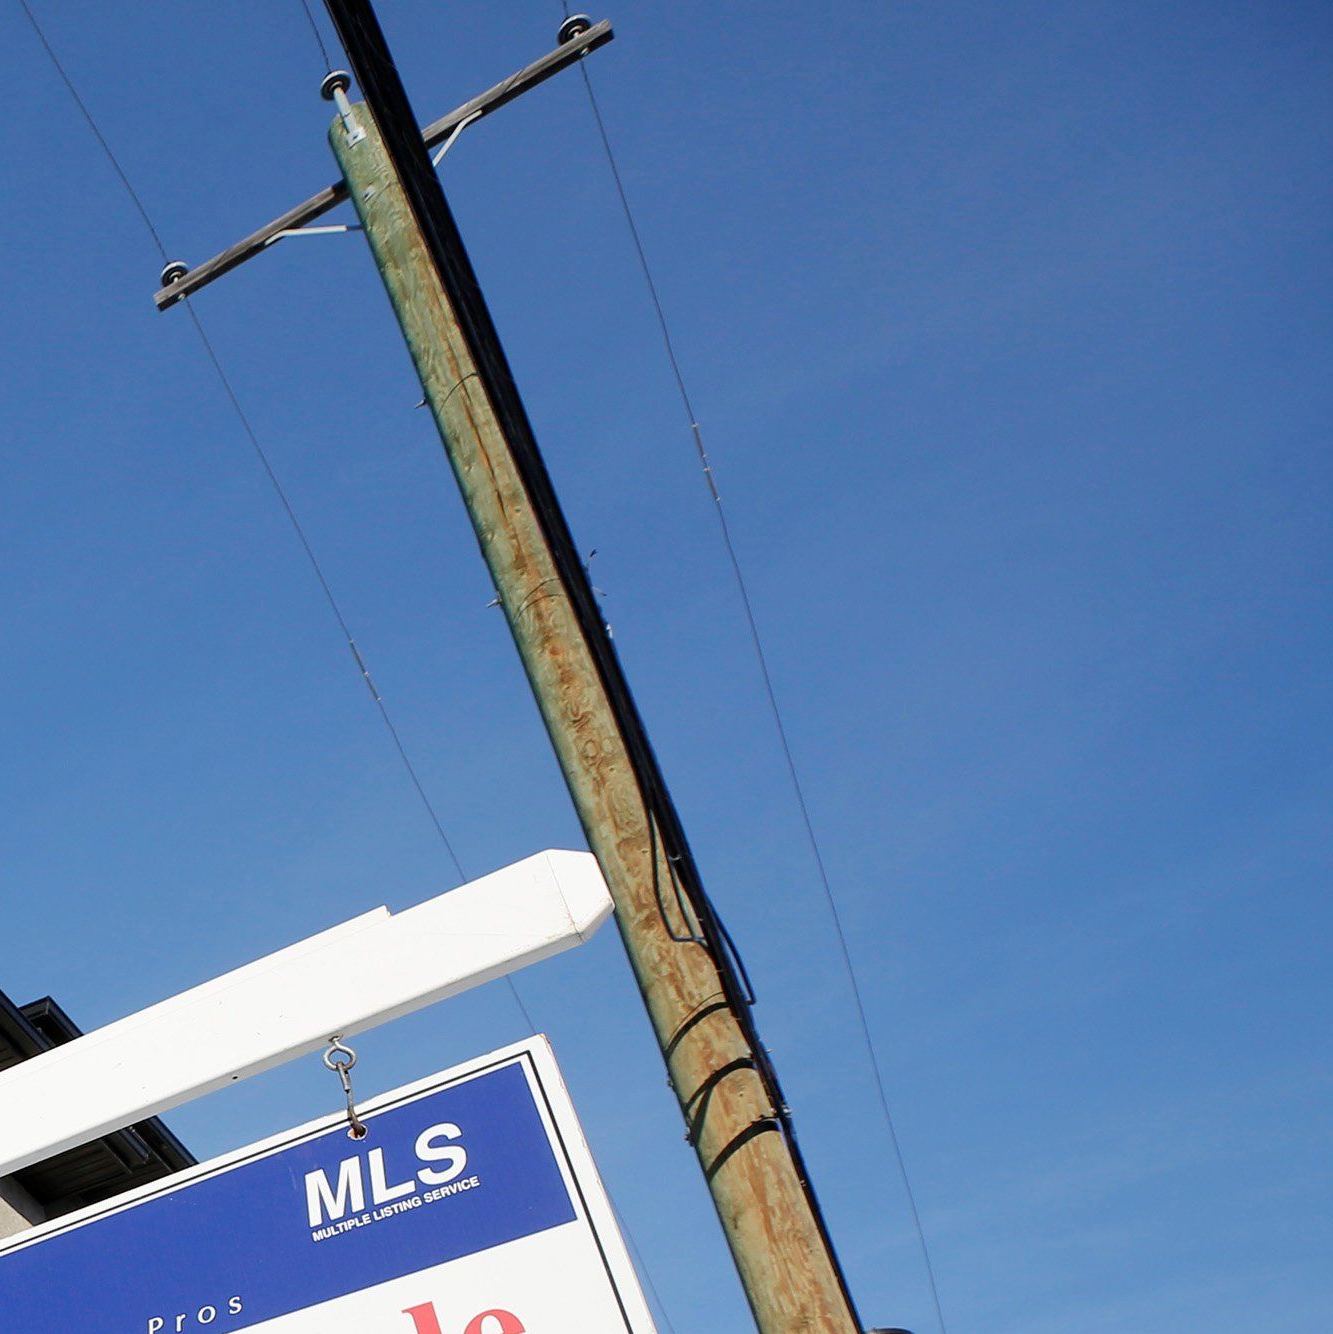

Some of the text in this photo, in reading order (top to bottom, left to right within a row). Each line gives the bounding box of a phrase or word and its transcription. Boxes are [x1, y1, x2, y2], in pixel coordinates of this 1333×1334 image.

[304, 1122, 468, 1228] MLS
[312, 1175, 481, 1242] MULTIPLE LISTING SERVICE
